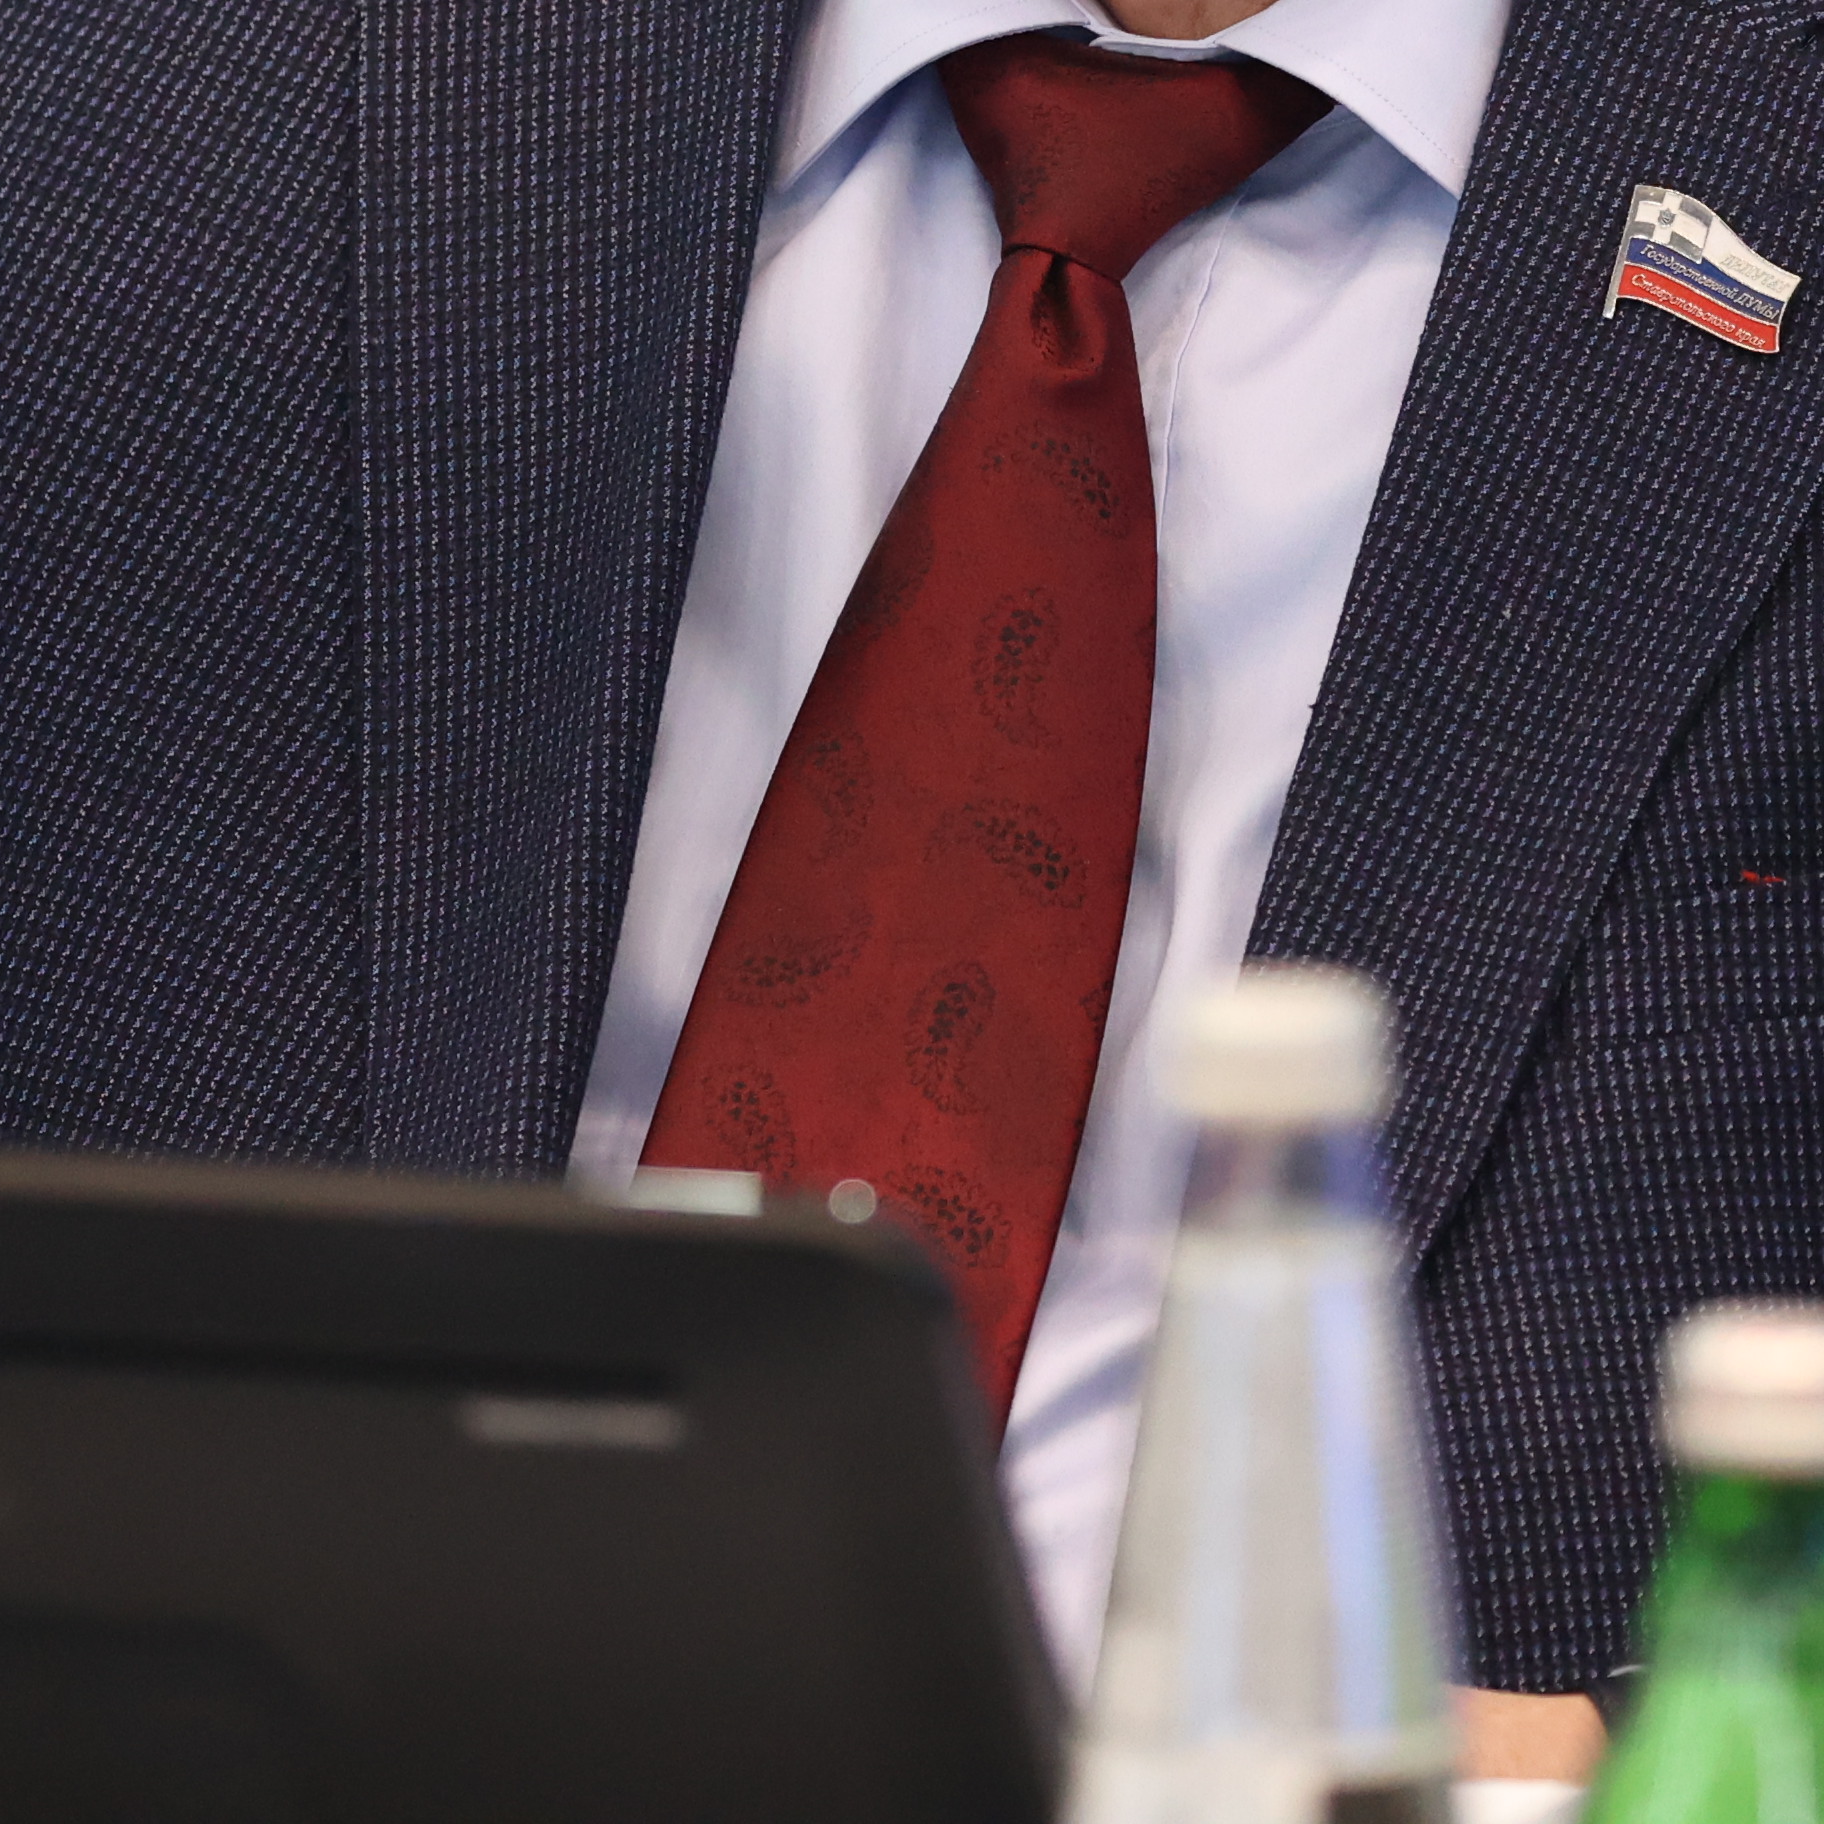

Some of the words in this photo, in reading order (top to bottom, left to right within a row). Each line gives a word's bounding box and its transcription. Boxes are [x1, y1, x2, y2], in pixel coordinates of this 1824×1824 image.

[1631, 273, 1736, 333] Ставропольского
[1735, 327, 1767, 348] края
[1640, 244, 1738, 303] Государственной
[1734, 292, 1780, 321] ДУМЫ
